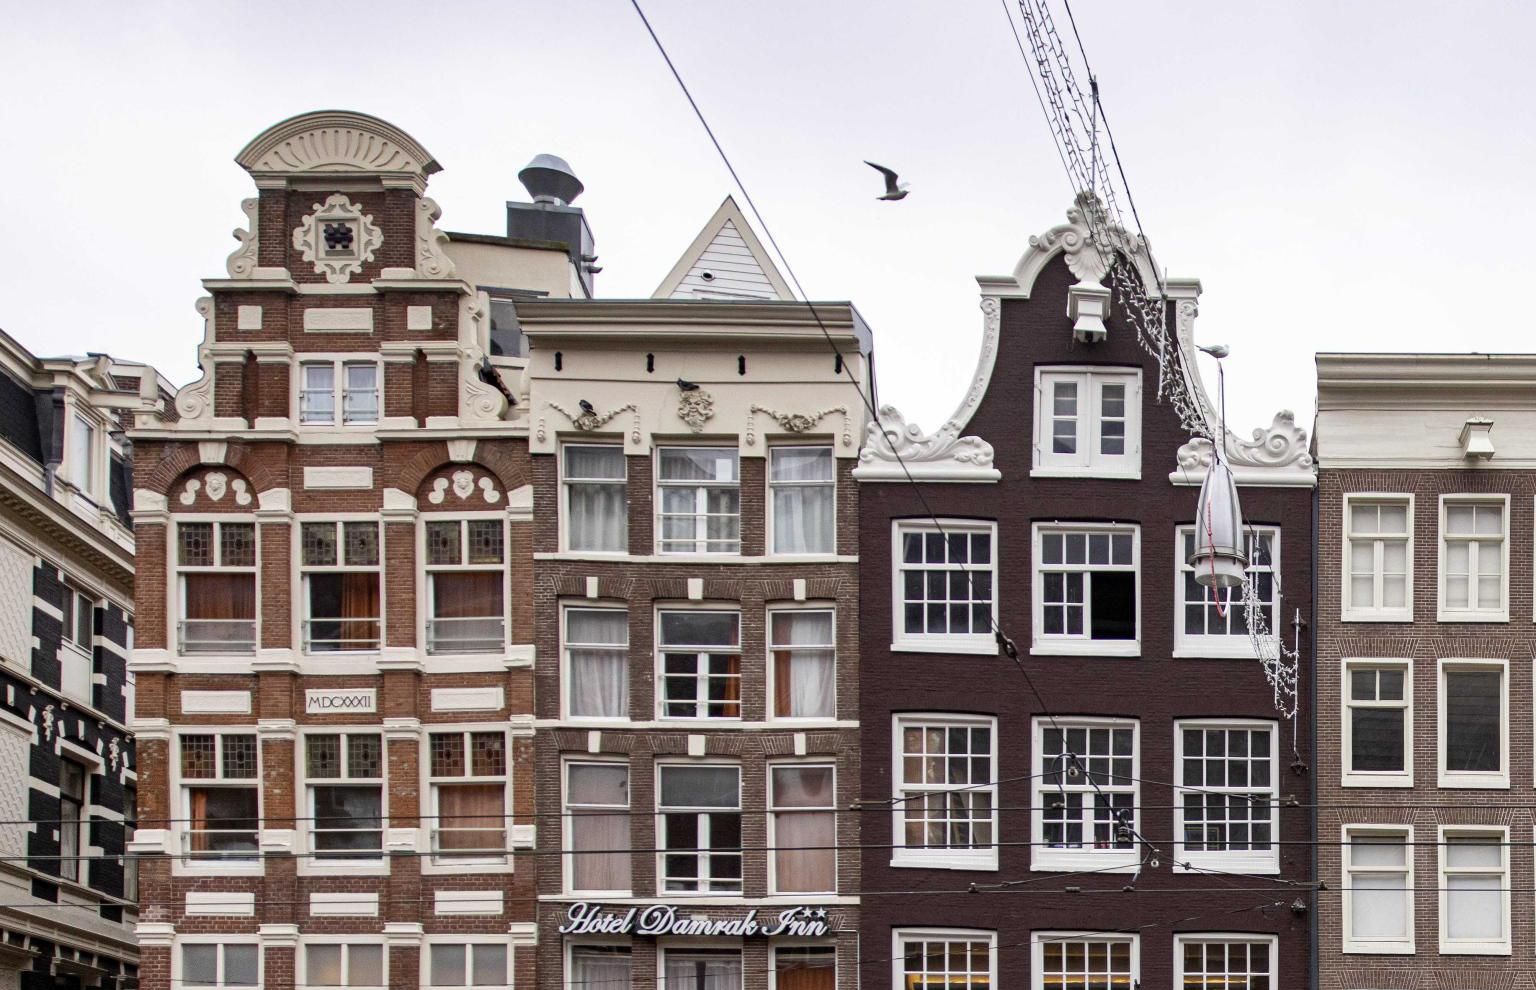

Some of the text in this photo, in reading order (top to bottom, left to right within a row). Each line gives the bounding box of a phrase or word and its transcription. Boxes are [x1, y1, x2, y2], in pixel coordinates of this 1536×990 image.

[308, 695, 372, 709] MDCXXXII
[559, 902, 828, 936] Hotel Damrak Inn
